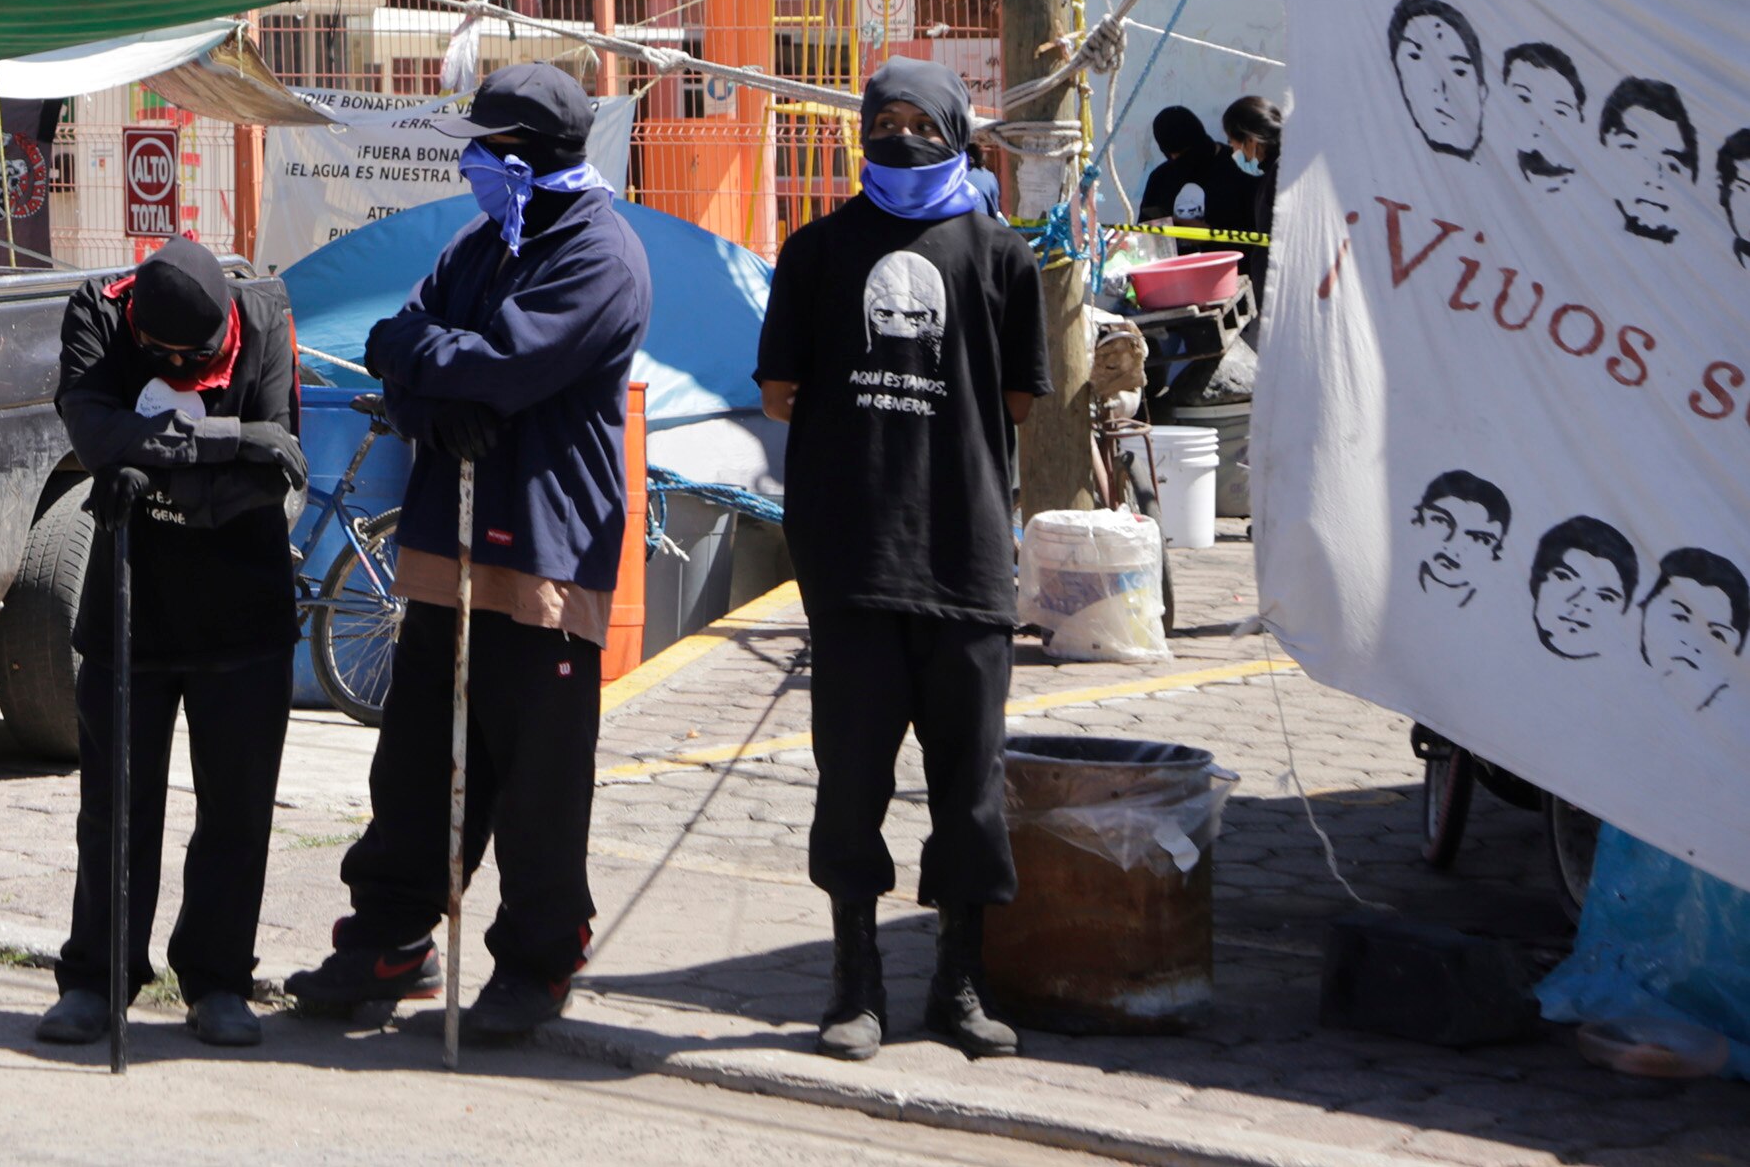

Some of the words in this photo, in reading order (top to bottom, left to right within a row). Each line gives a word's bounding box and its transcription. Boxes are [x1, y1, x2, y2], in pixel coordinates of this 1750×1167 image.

[357, 145, 411, 161] ¡FUERA
[135, 155, 168, 184] ALTO
[285, 162, 308, 177] ¡EL
[311, 163, 350, 178] AGUA
[355, 165, 374, 180] ES
[379, 166, 451, 183] NUESTRA
[130, 204, 174, 233] TOTAL
[367, 206, 407, 220] ATE
[873, 393, 936, 416] GENERAL
[1687, 360, 1750, 430] s
